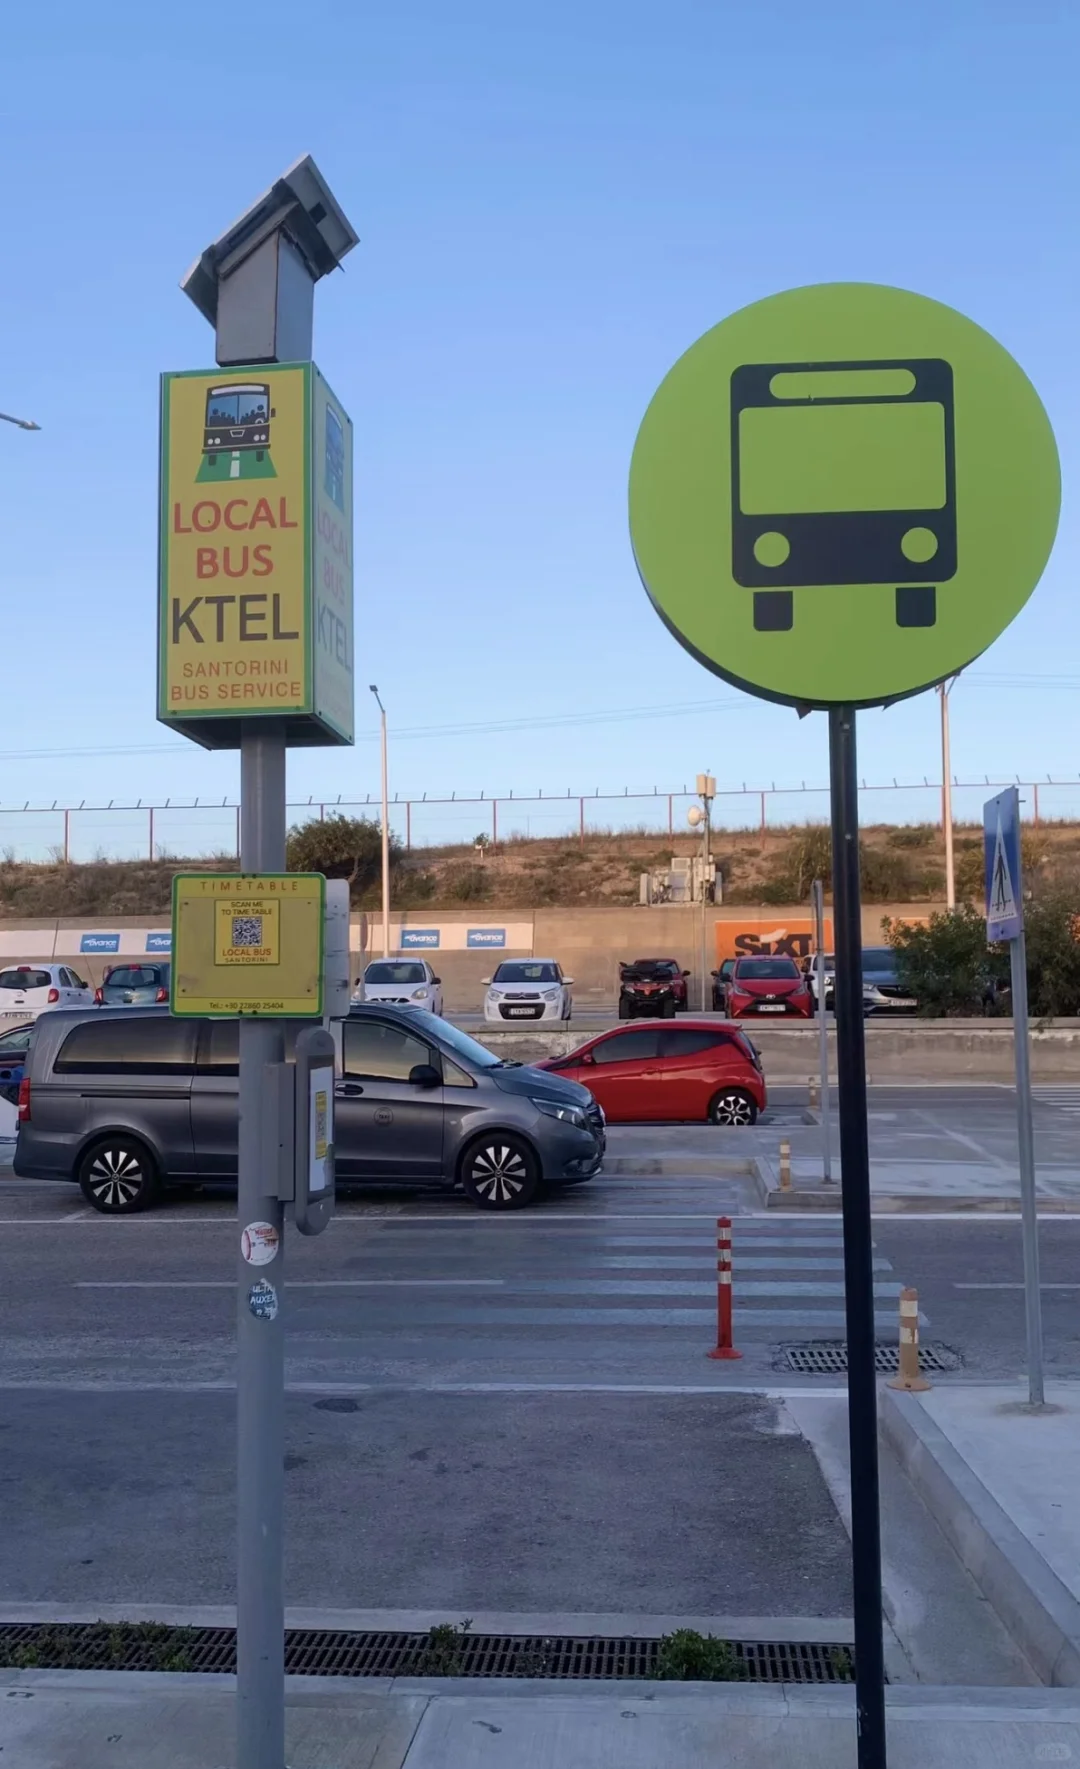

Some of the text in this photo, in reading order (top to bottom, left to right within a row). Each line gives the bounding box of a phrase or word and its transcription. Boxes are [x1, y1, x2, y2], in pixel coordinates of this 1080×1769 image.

[173, 497, 298, 534] LOCAL
[317, 506, 350, 568] LOCAL
[196, 544, 274, 579] BUS
[323, 556, 345, 606] BUS
[172, 593, 299, 645] KTEL
[317, 598, 352, 674] KTEL
[182, 658, 288, 678] SANTORINI
[171, 681, 301, 701] BUS SERVICE
[201, 881, 298, 891] TIMETABLE
[222, 948, 272, 956] LOCAL BUS
